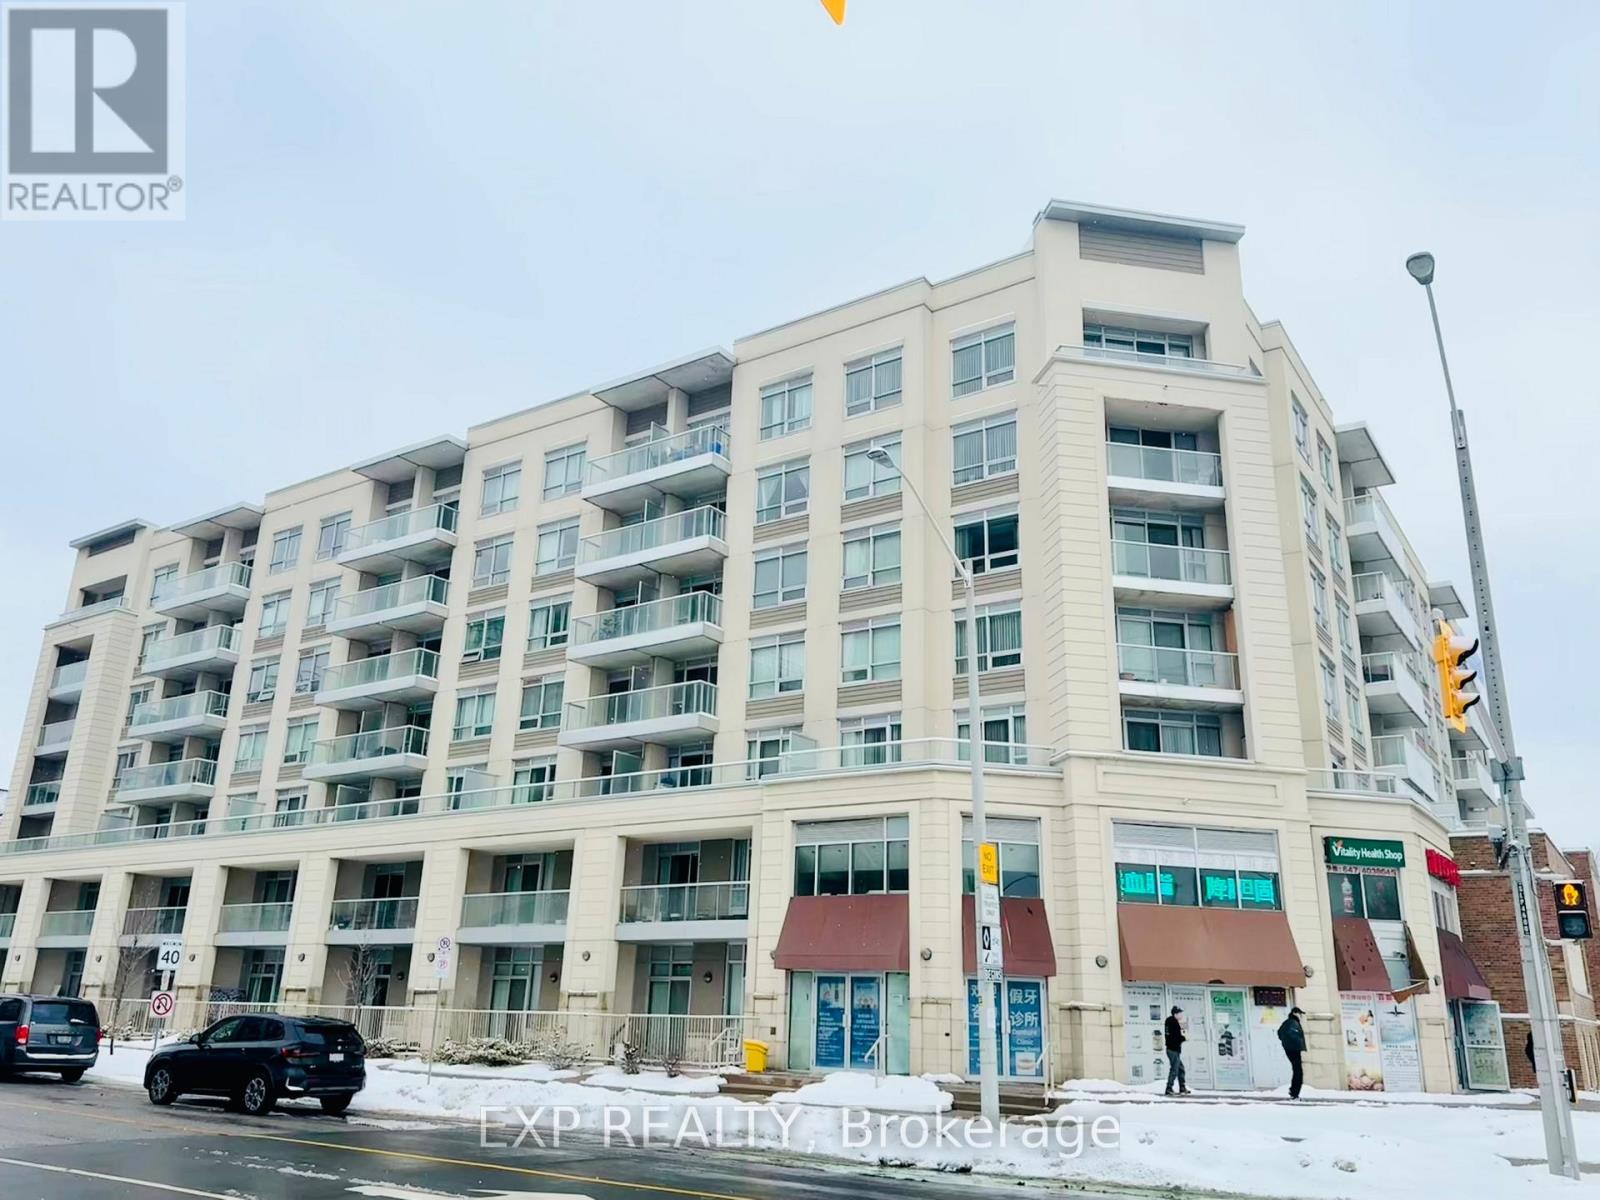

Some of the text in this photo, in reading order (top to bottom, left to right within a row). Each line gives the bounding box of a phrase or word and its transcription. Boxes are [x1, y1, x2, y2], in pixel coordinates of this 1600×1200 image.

[983, 851, 992, 862] NO
[1331, 842, 1403, 862] Vitality Health Shop
[982, 863, 994, 874] EXIT
[161, 950, 180, 965] 40
[1009, 988, 1037, 1005] 假牙
[1010, 1011, 1038, 1027] 诊所
